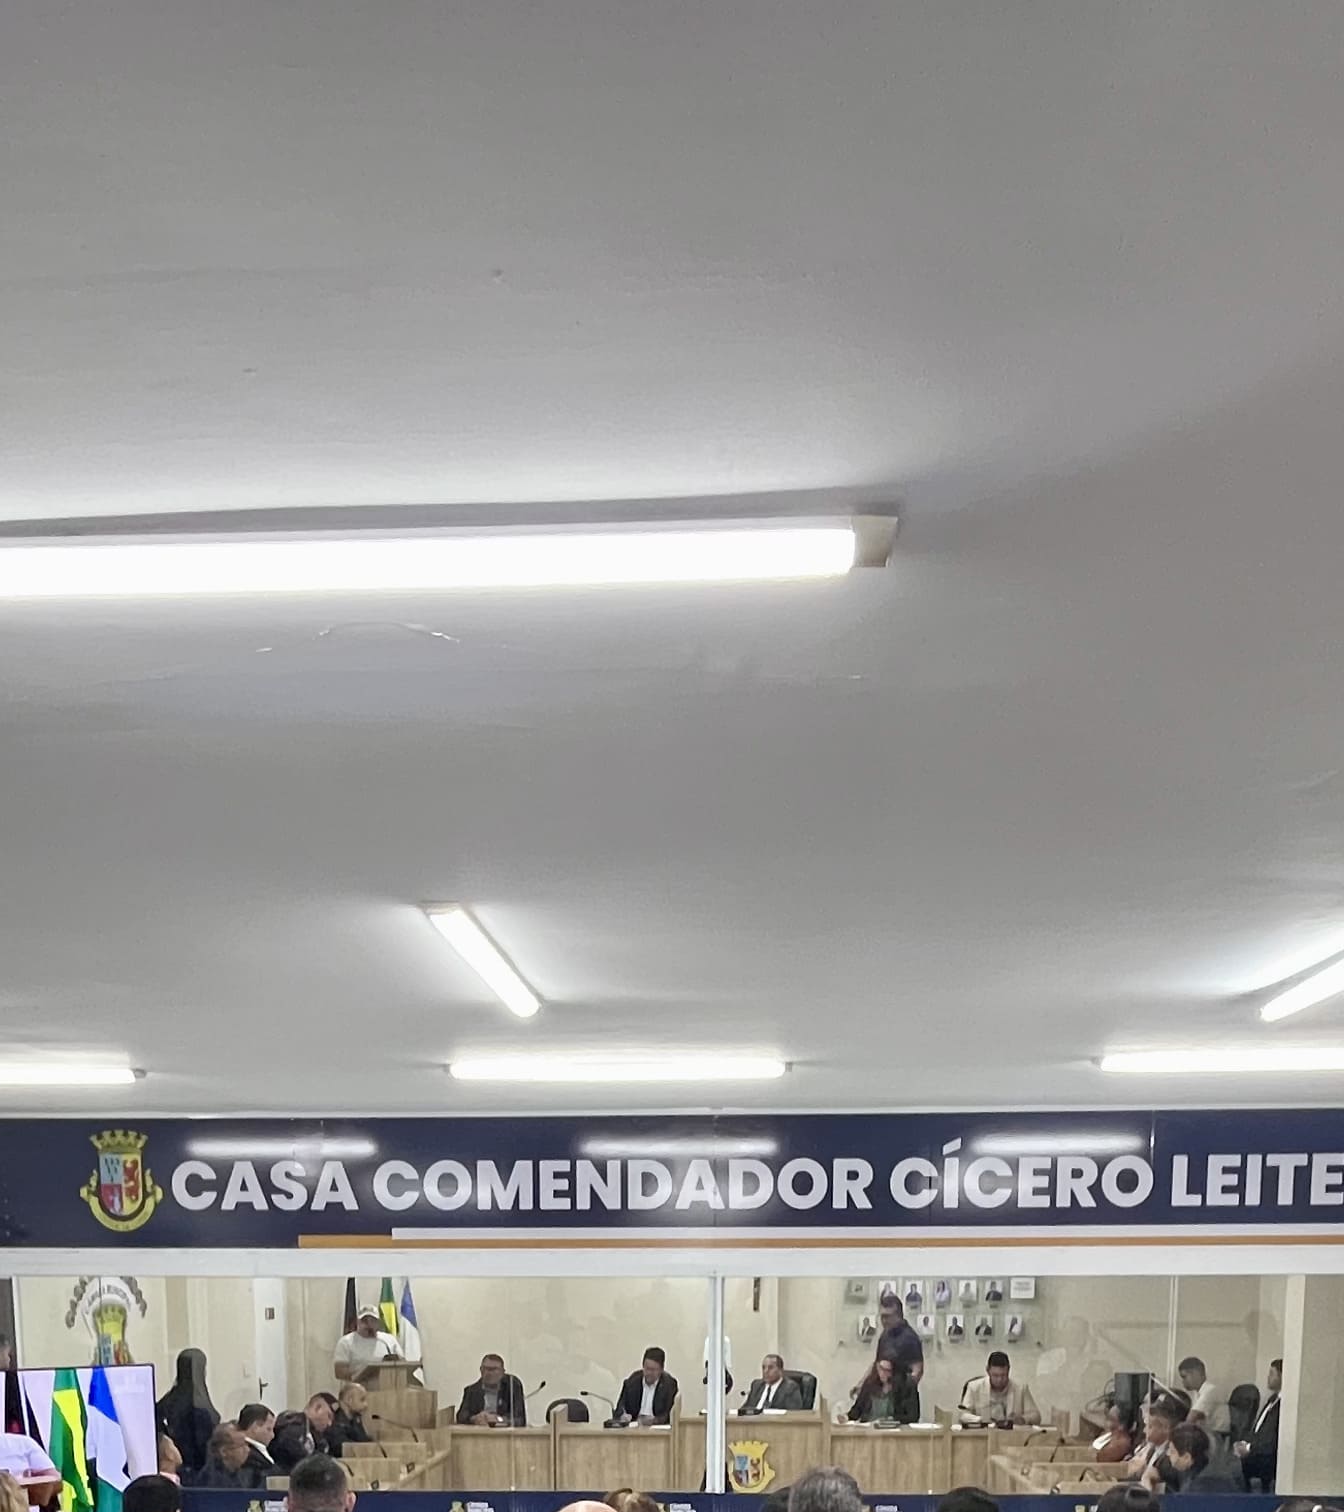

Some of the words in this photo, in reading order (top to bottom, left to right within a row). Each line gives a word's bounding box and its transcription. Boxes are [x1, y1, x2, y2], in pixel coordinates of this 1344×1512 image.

[170, 1159, 360, 1212] CASA
[372, 1156, 874, 1211] COMENDADOR
[889, 1137, 1154, 1209] CÍCERO
